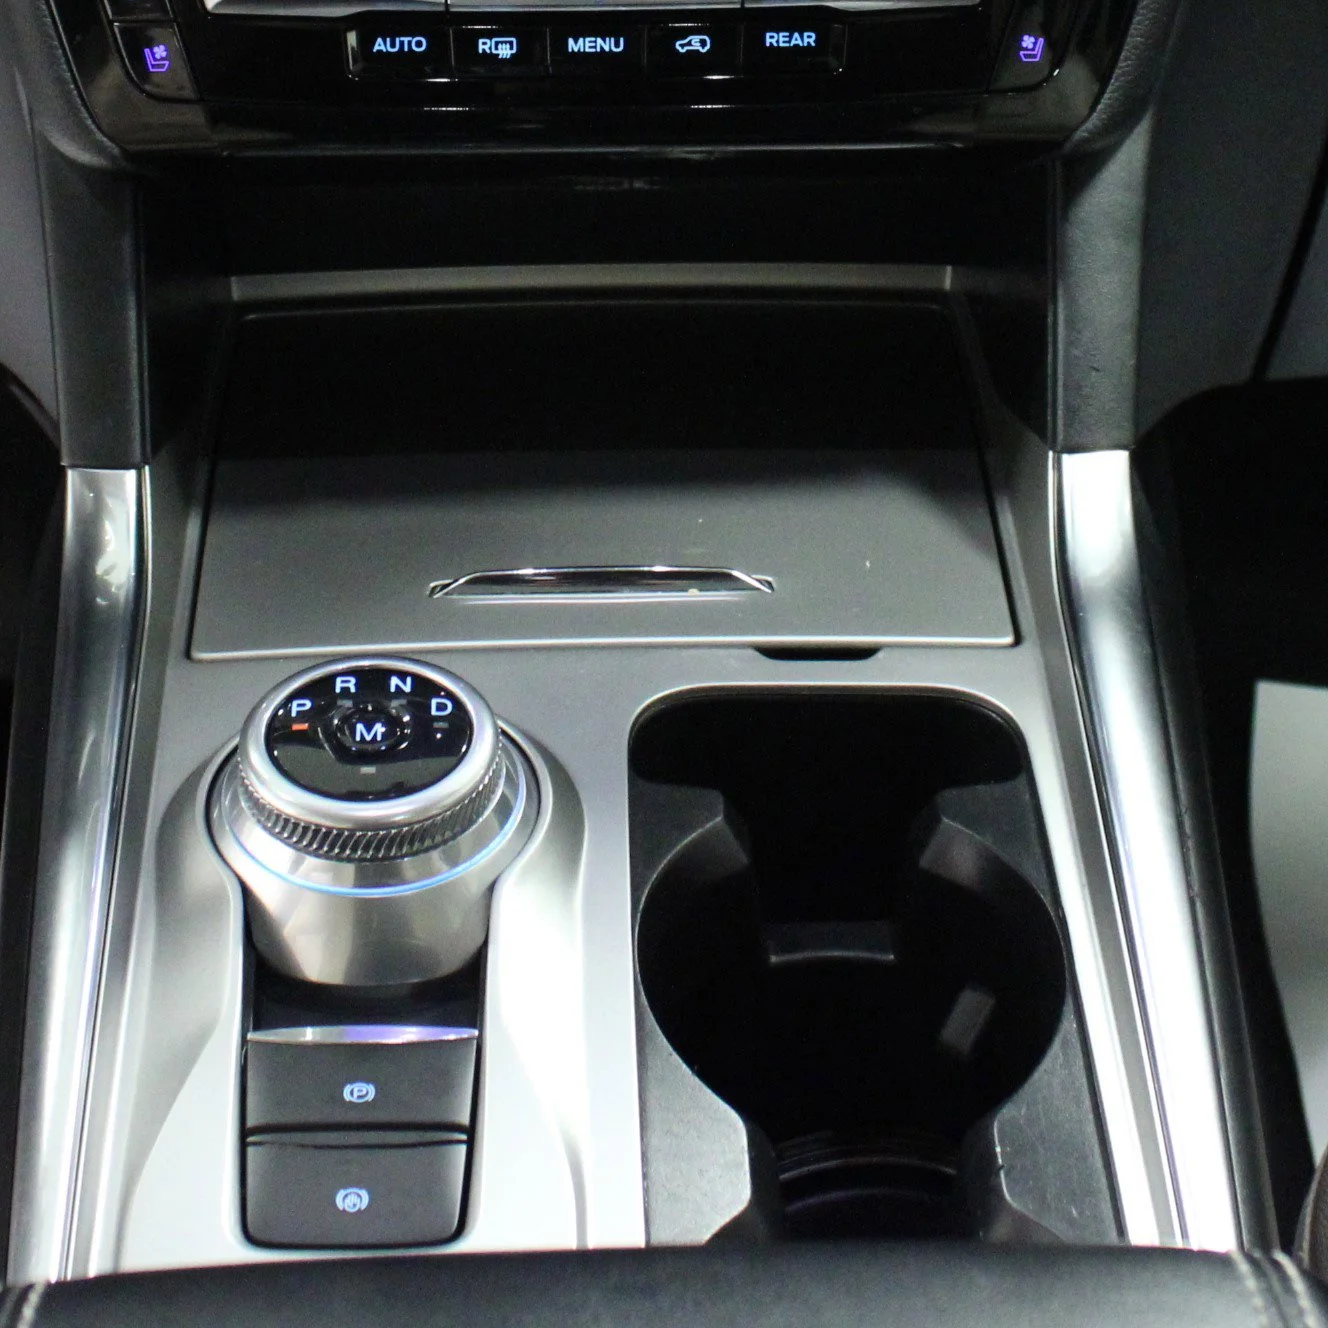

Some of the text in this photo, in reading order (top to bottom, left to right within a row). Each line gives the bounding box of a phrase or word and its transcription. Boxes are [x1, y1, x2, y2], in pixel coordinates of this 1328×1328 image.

[373, 37, 427, 53] AUTO
[568, 37, 624, 53] MENU
[765, 31, 816, 48] REAR
[335, 676, 356, 694] R
[389, 676, 413, 694] N
[290, 699, 312, 718] P
[430, 698, 453, 717] D
[354, 722, 381, 741] M
